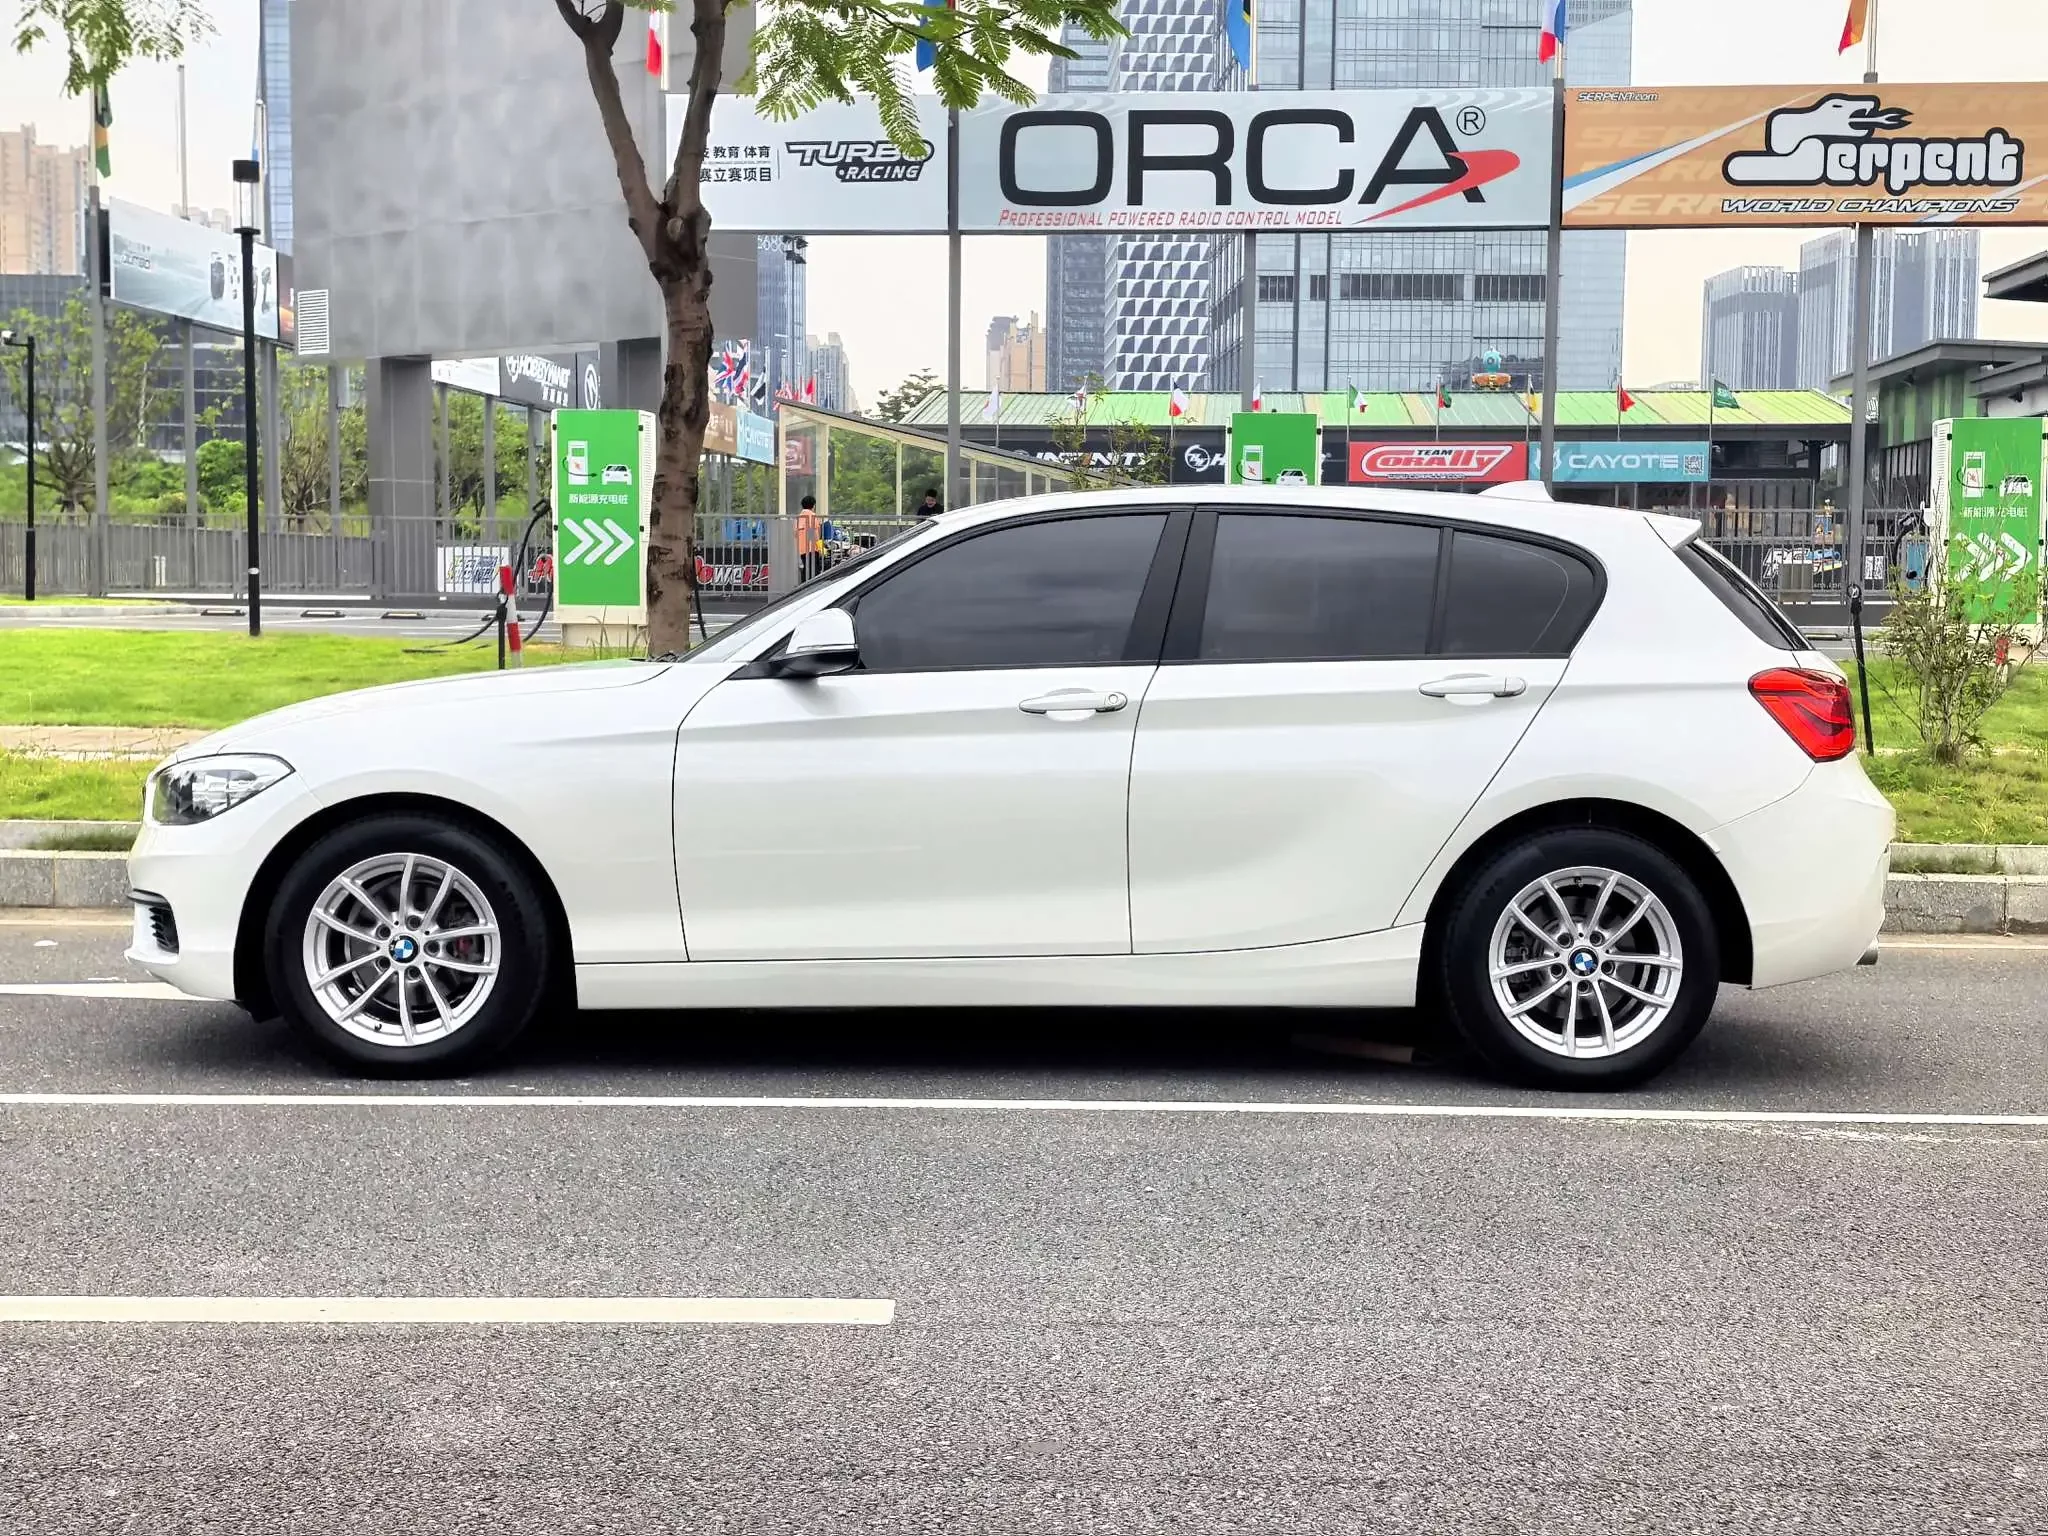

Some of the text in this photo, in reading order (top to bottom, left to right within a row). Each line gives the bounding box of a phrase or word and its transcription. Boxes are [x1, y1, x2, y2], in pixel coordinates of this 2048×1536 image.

[999, 106, 1486, 206] ORCA
[1721, 198, 1834, 212] WORLD
[1837, 198, 2019, 213] CHAMPIONS
[999, 209, 1342, 226] PROFESSIONAL POWERED RADIO CONTROL MODEL
[1568, 454, 1679, 469] CAYOTE
[568, 493, 629, 505] 新能源充电桩
